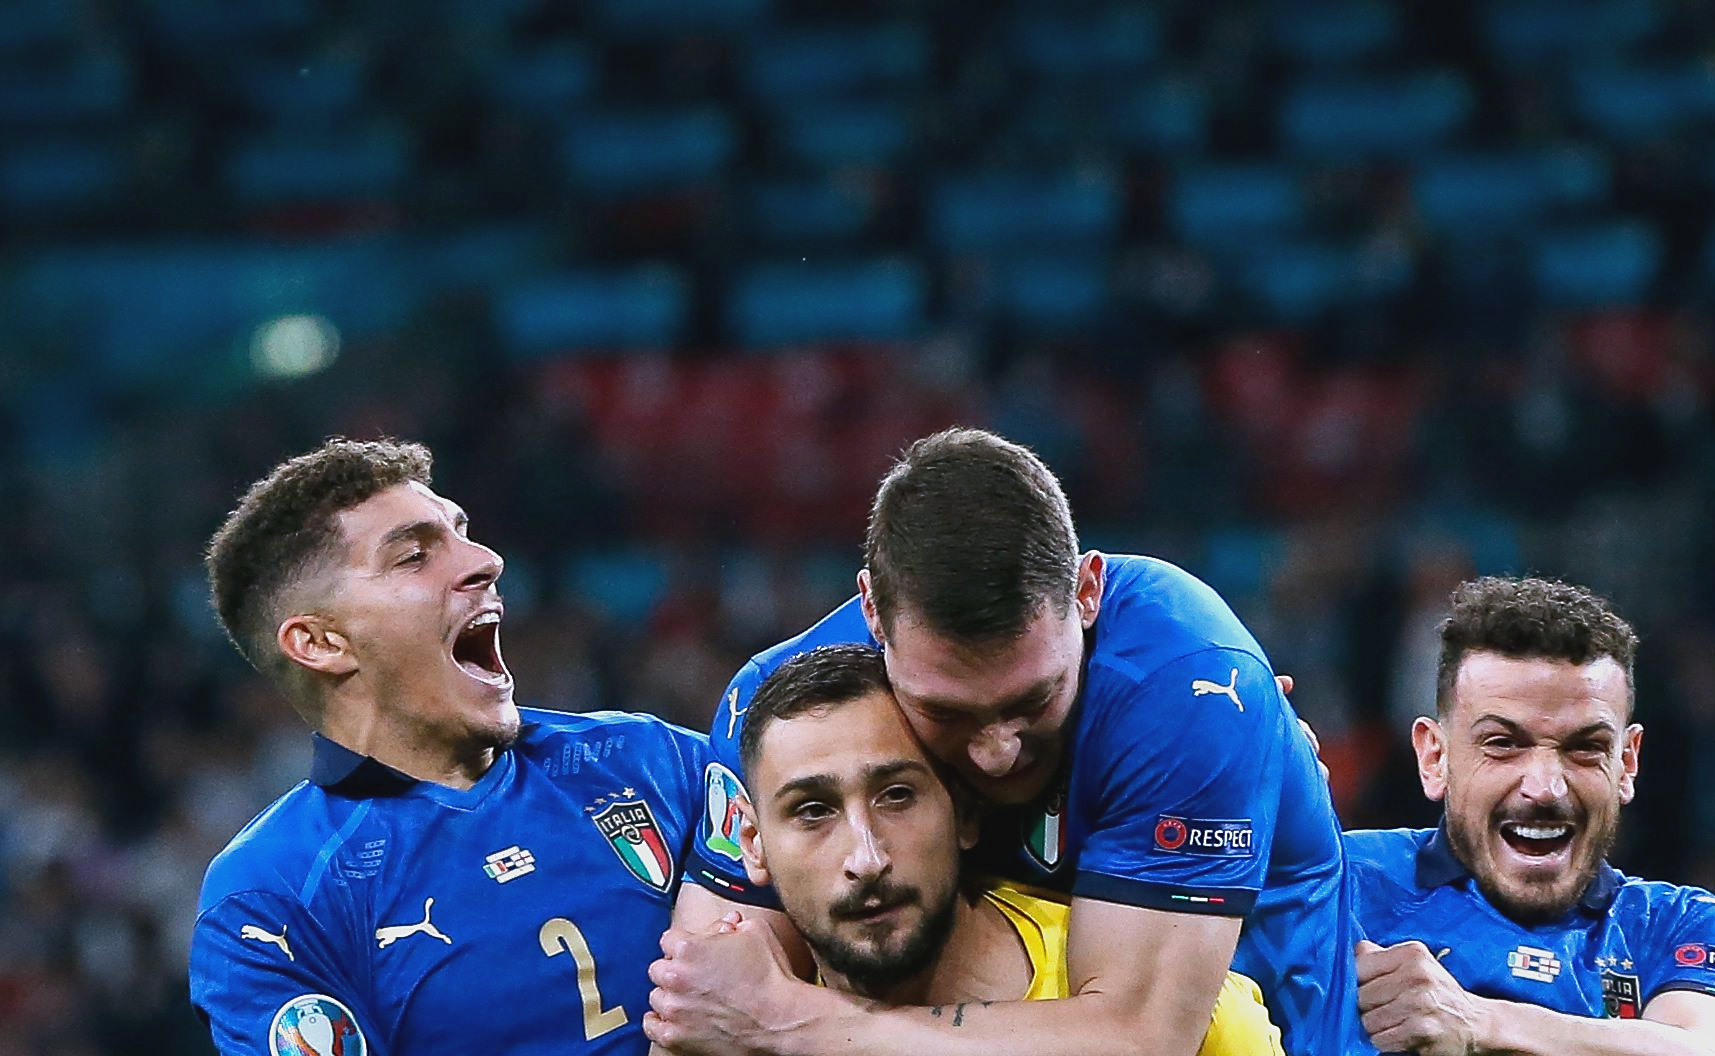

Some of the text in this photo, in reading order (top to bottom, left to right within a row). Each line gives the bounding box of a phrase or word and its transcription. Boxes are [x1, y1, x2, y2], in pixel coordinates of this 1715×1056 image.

[600, 808, 646, 832] ITALIA
[1189, 829, 1252, 848] RESPECT
[539, 917, 628, 1041] 2
